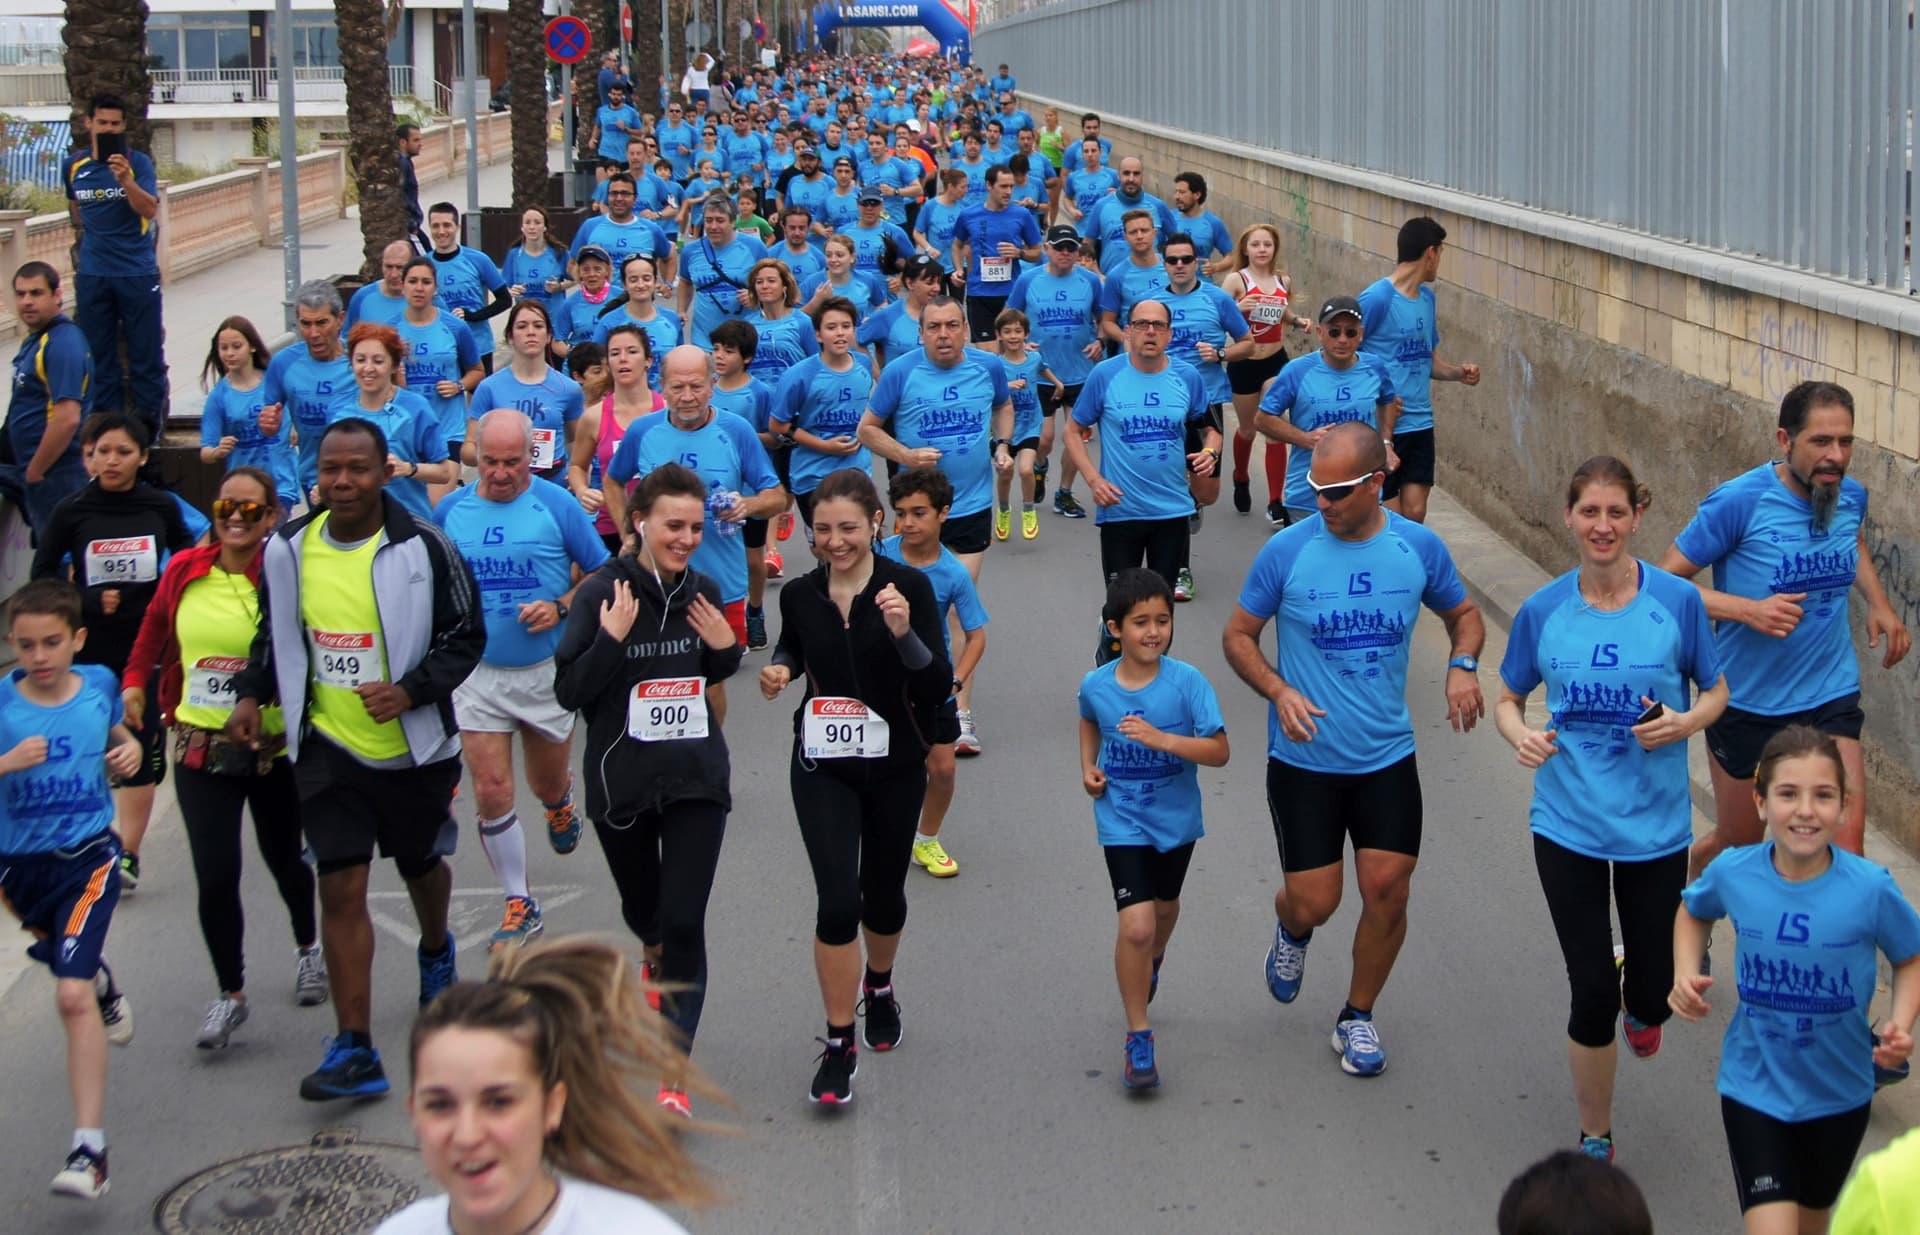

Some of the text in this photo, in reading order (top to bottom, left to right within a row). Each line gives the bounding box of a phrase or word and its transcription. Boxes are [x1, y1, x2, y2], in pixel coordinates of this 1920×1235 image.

[988, 267, 1005, 276] 881
[1259, 308, 1282, 319] 1000
[839, 387, 852, 402] LS
[943, 386, 959, 401] LS
[1143, 392, 1160, 407] LS
[1336, 387, 1352, 401] LS
[482, 526, 505, 545] LS
[104, 559, 137, 573] 951
[1348, 571, 1373, 596] LS
[324, 655, 360, 675] 949
[1591, 643, 1619, 668] LS
[207, 676, 240, 695] 94
[651, 706, 689, 726] 900
[826, 724, 865, 743] 901
[1776, 911, 1811, 944] LS
